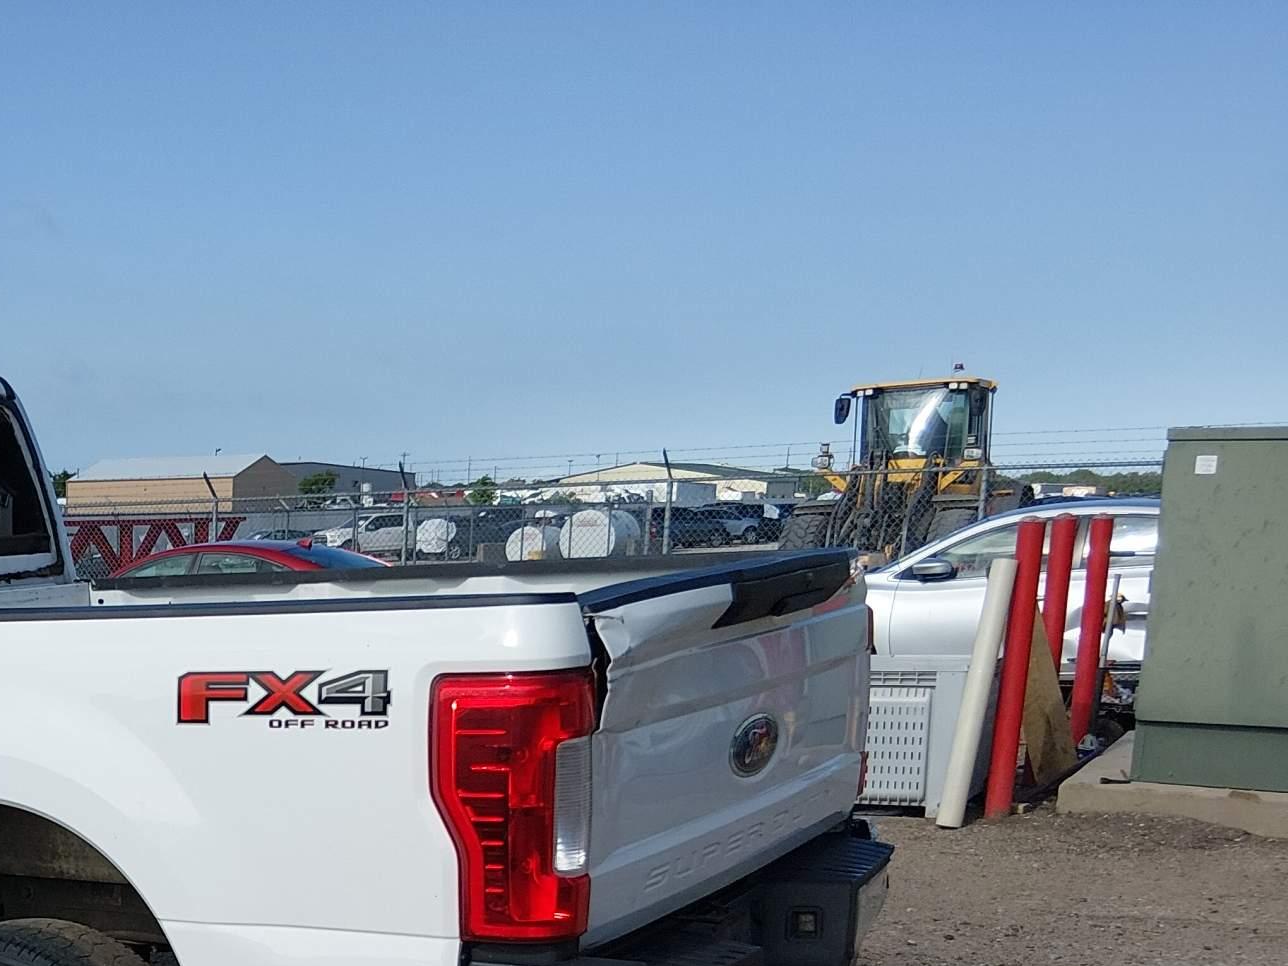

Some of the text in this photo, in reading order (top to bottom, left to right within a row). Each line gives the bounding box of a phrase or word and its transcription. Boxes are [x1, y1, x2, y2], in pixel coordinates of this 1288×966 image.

[177, 669, 392, 724] FX4
[268, 719, 390, 730] OFF ROAD
[643, 821, 766, 892] SUPER
